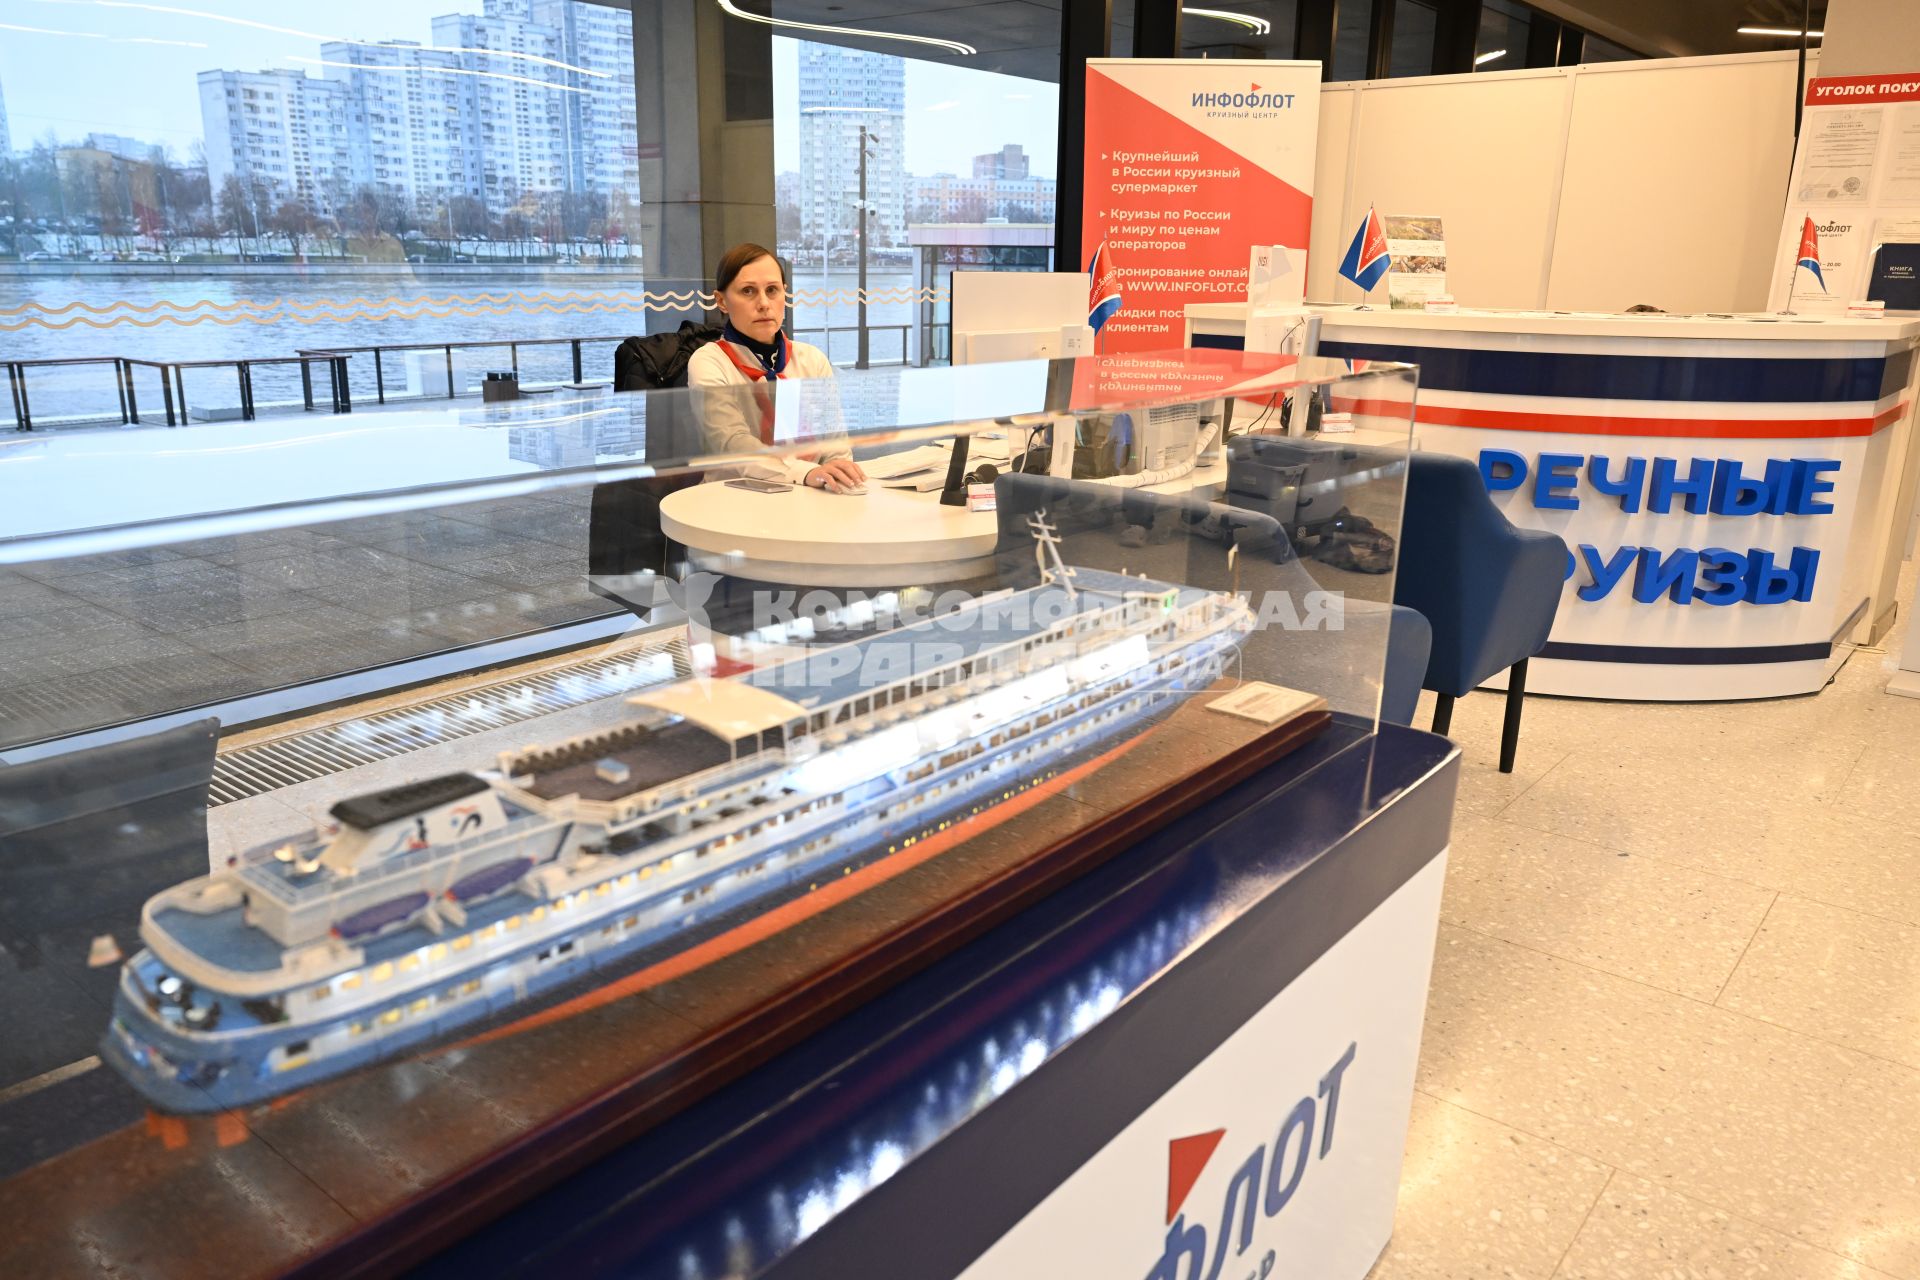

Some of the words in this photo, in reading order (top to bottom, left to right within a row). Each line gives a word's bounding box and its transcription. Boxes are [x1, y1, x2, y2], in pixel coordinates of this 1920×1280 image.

[1816, 84, 1876, 96] УГОЛОК
[1192, 92, 1295, 108] ИНФОФЛОТ
[1112, 151, 1199, 163] Крупнейший
[1112, 168, 1119, 176] в
[1123, 166, 1171, 177] России
[1174, 167, 1240, 179] круизный
[1111, 183, 1198, 194] супермаркет
[1110, 209, 1160, 221] Круизы
[1164, 211, 1180, 219] по
[1183, 209, 1231, 220] России
[1109, 226, 1118, 234] и
[1122, 226, 1155, 236] миру
[1159, 226, 1175, 234] по
[1178, 226, 1220, 236] ценам
[1109, 240, 1186, 251] операторов
[1208, 267, 1248, 278] онлай
[1111, 308, 1156, 319] кидки
[1106, 322, 1169, 333] клиентам
[1479, 448, 1841, 516] РЕЧНЫЕ
[1563, 542, 1821, 606] УИЗЫ
